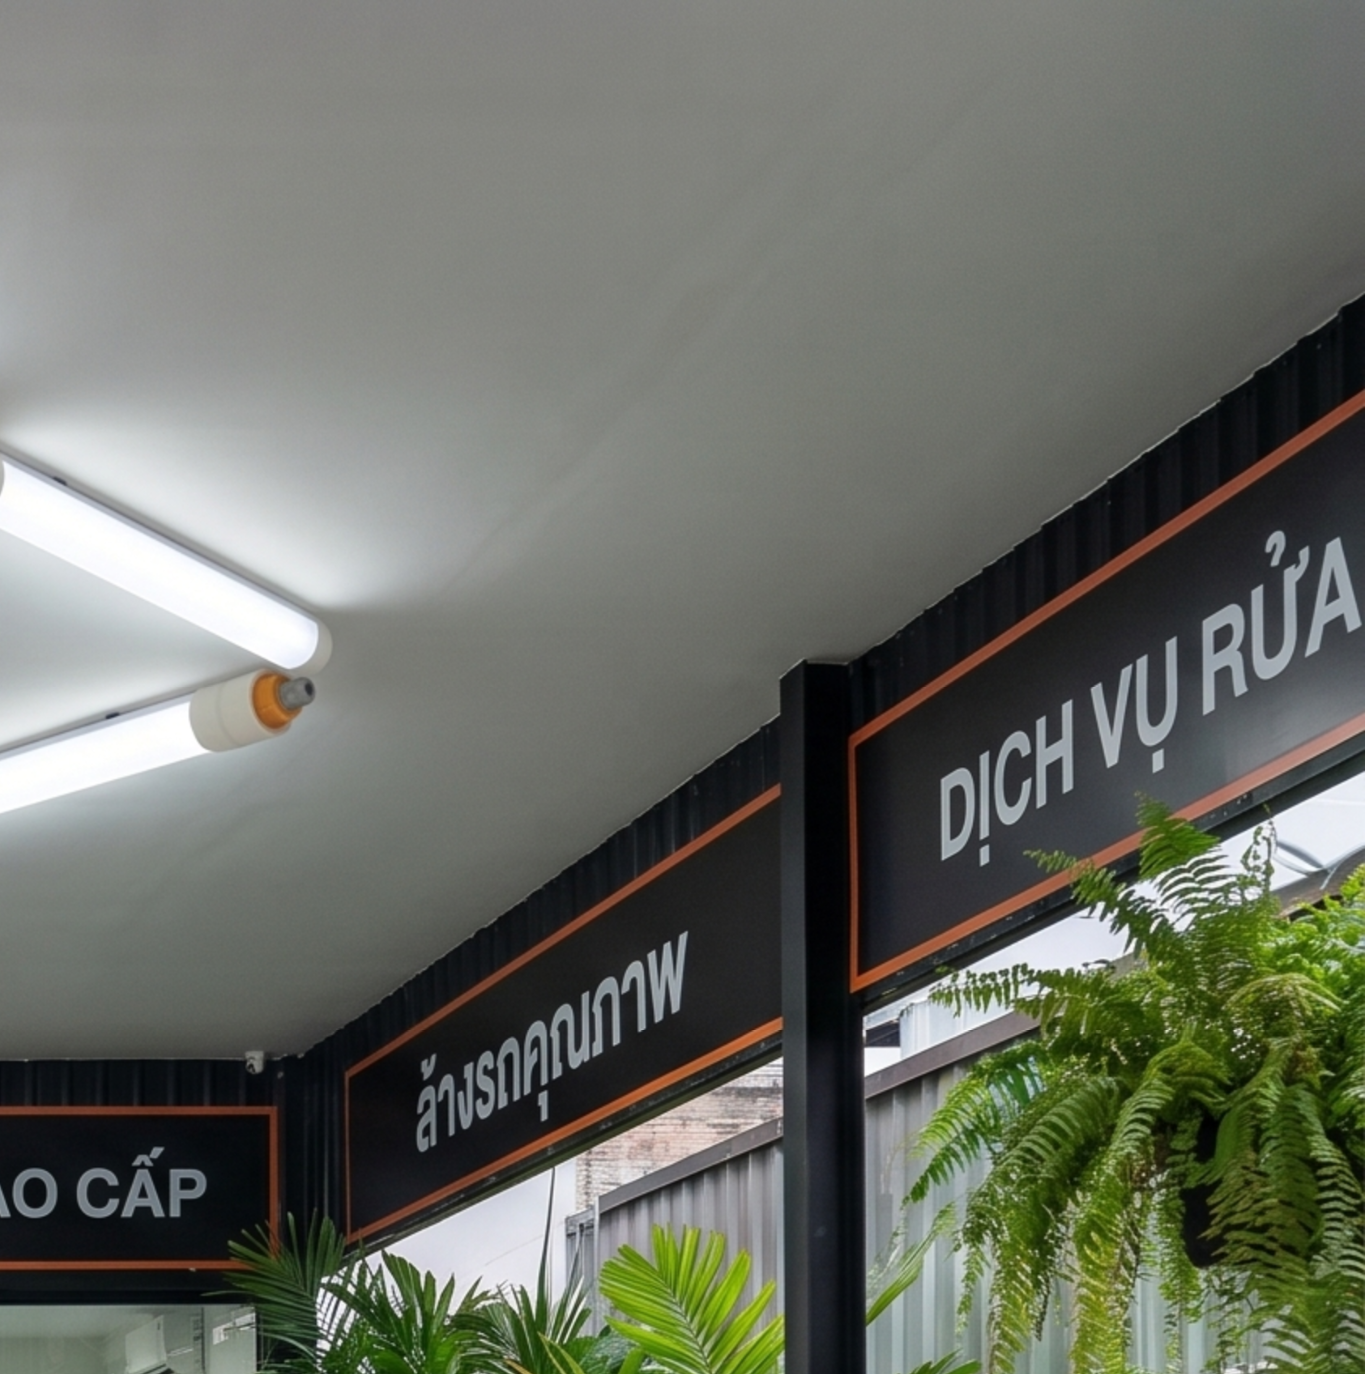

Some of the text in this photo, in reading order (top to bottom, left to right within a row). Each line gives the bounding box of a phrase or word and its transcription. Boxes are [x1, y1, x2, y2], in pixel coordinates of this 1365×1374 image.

[940, 530, 1363, 867] DỊCH VỤ RỬA
[416, 930, 689, 1152] ล้างรถคุณภาพ
[76, 1147, 207, 1218] CẤP
